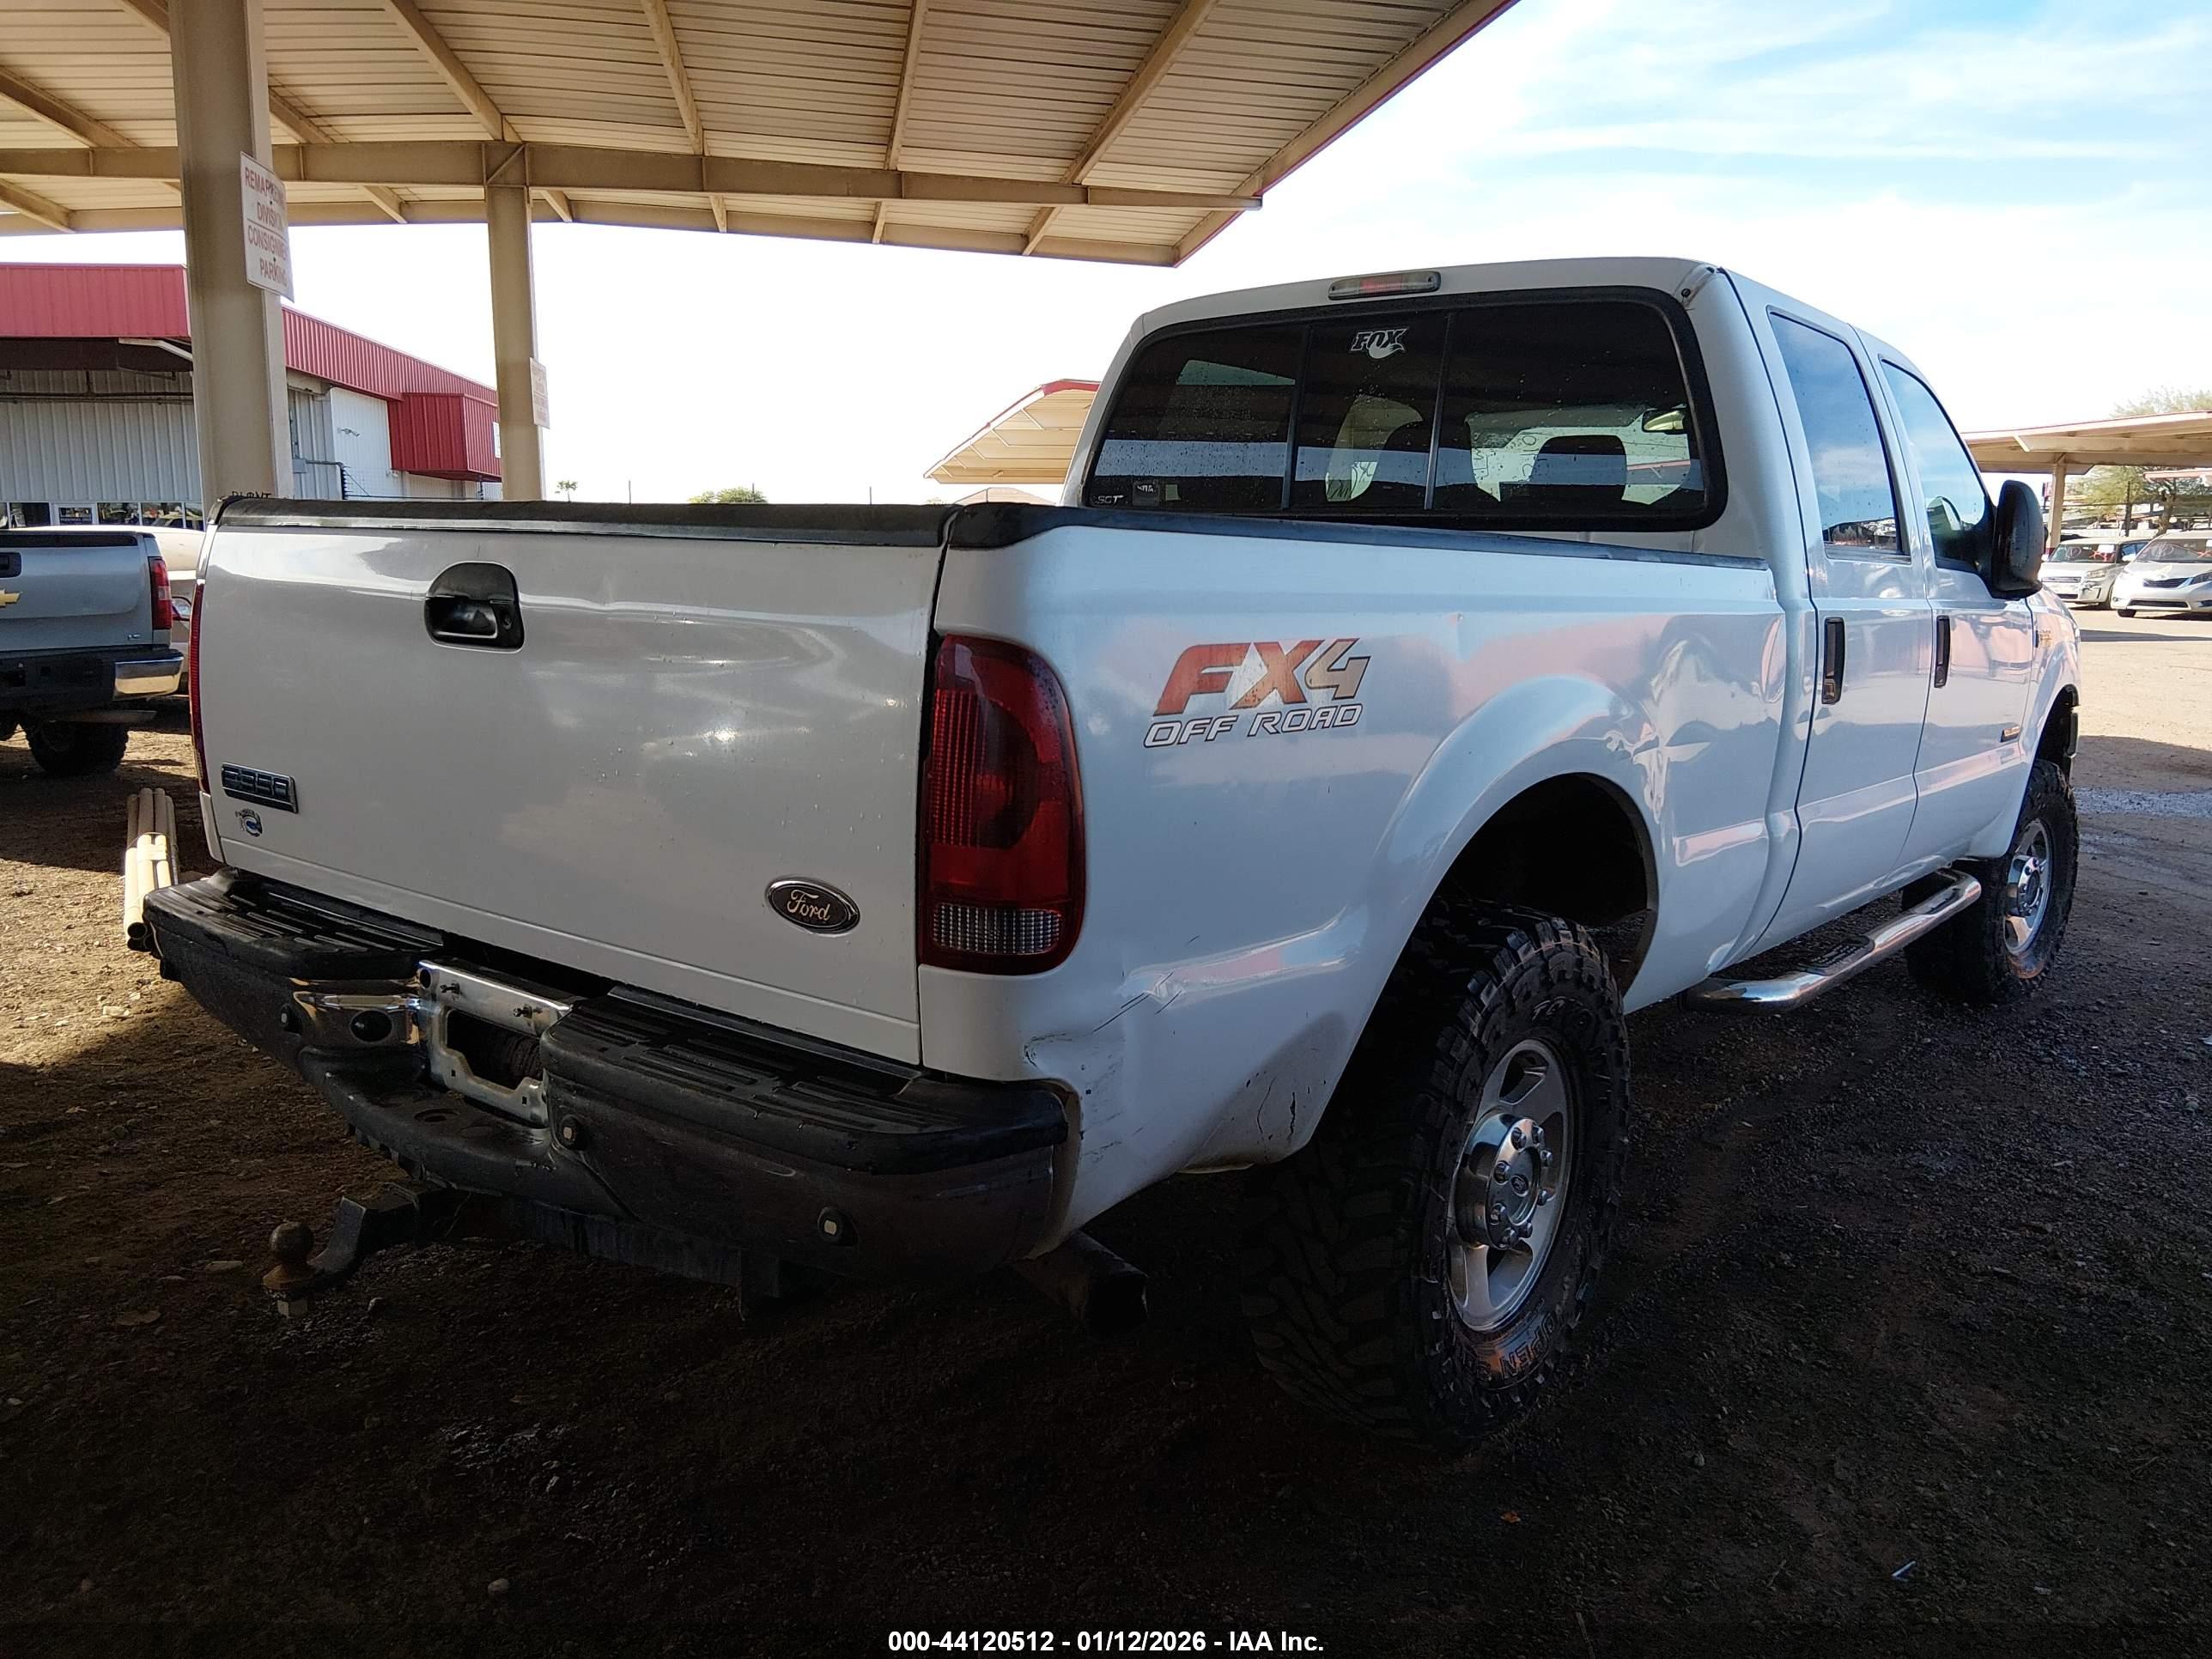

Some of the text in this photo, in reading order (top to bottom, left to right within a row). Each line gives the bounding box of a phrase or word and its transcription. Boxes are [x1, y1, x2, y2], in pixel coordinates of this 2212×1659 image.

[1351, 329, 1408, 354] FOX
[1153, 638, 1371, 716] FX4
[1143, 703, 1363, 748] OFF ROAD
[787, 889, 831, 921] Ford
